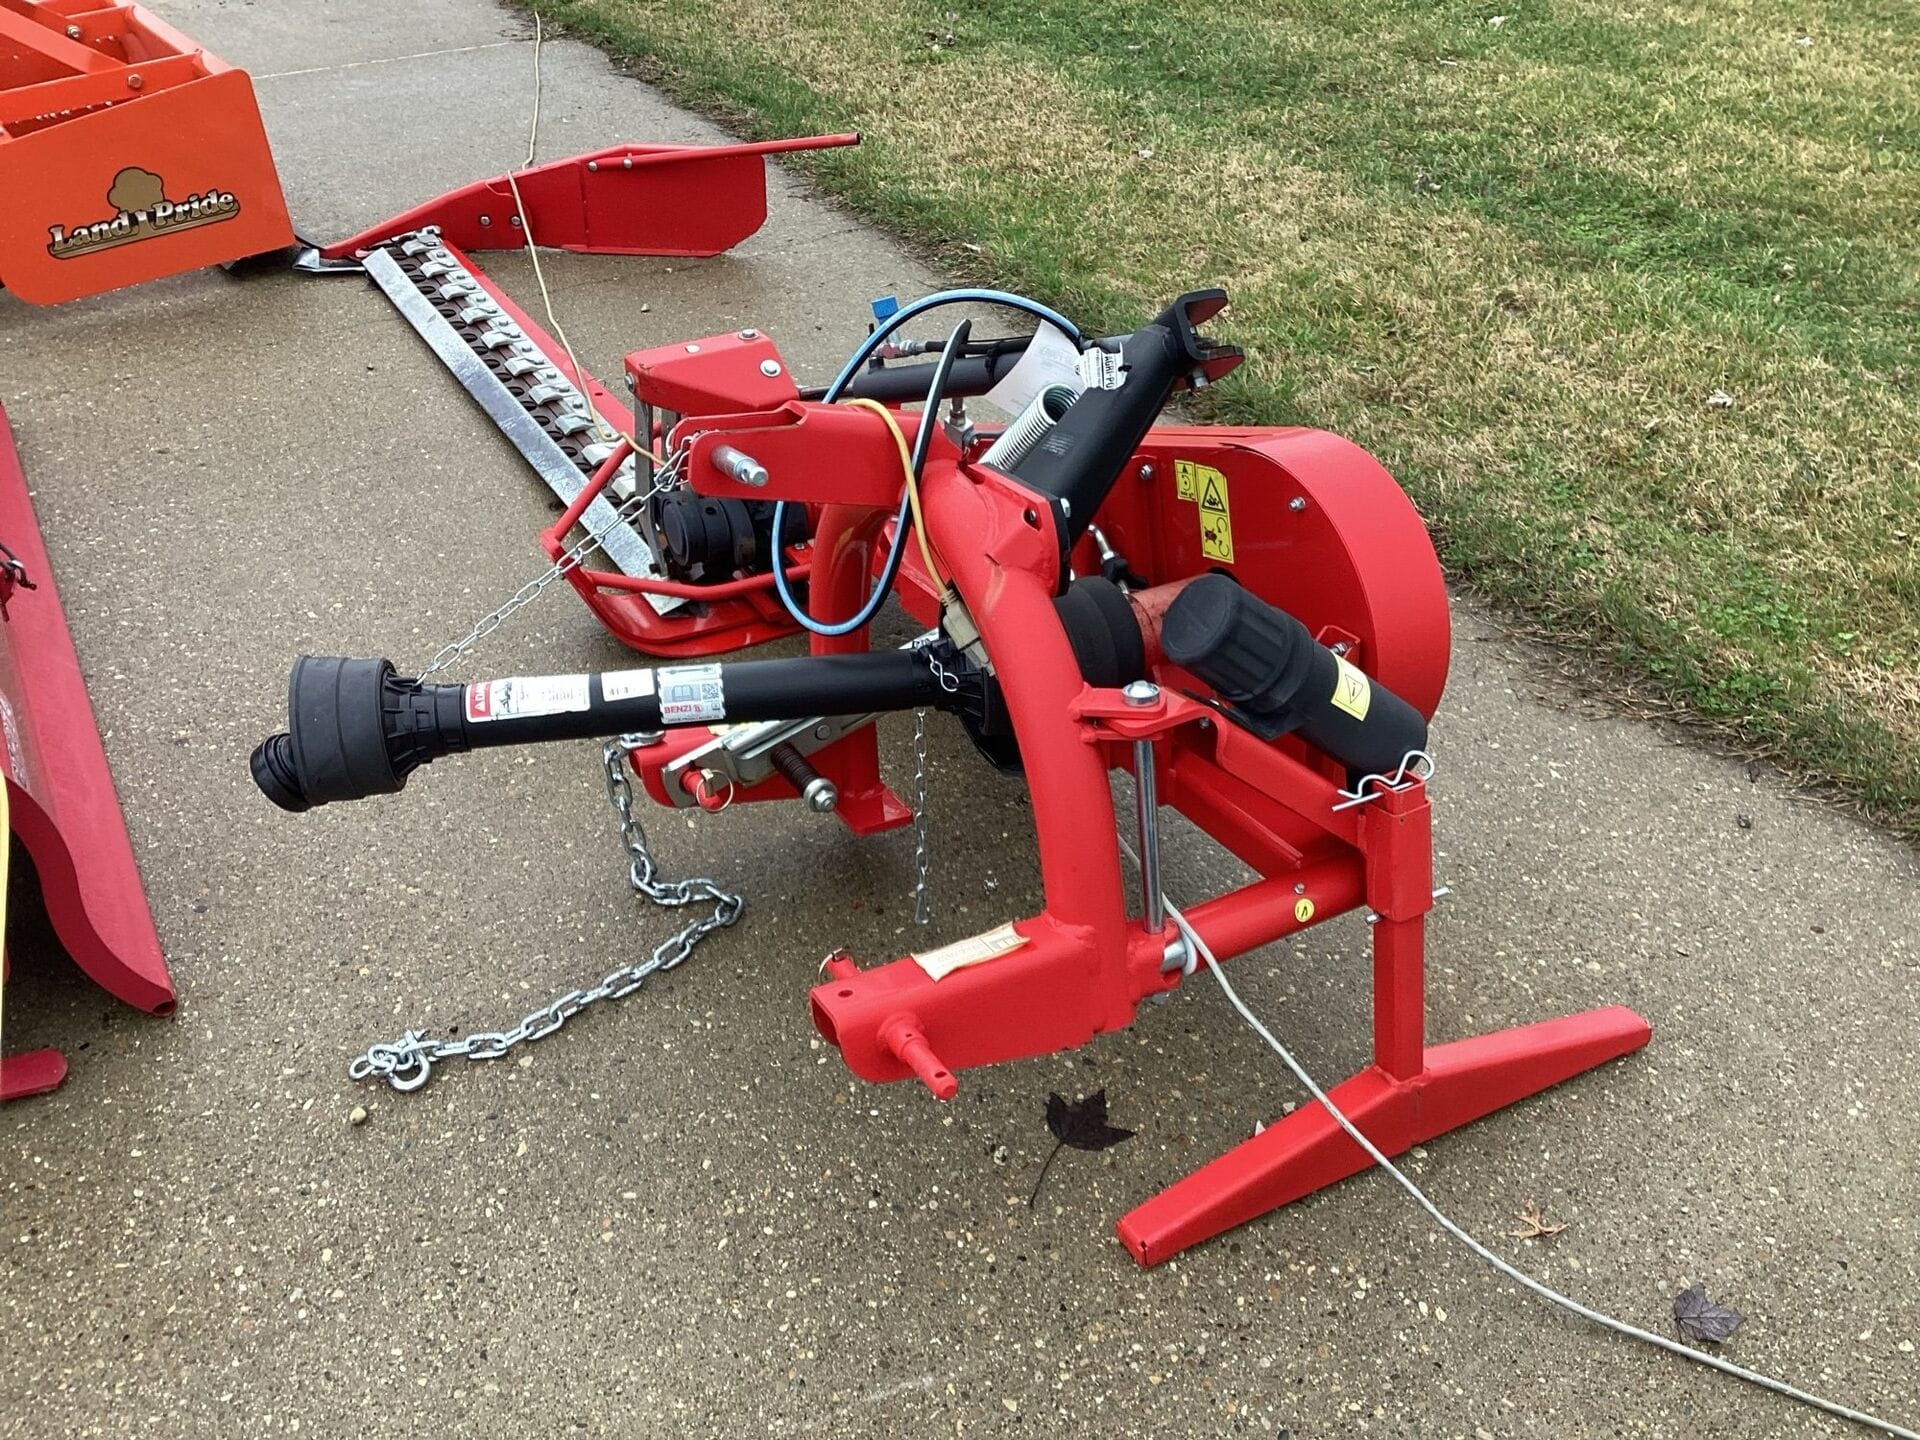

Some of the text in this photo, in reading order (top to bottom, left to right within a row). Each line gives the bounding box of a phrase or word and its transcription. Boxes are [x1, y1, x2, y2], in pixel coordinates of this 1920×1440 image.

[49, 189, 235, 251] Land Pride
[663, 704, 692, 714] BENZI
